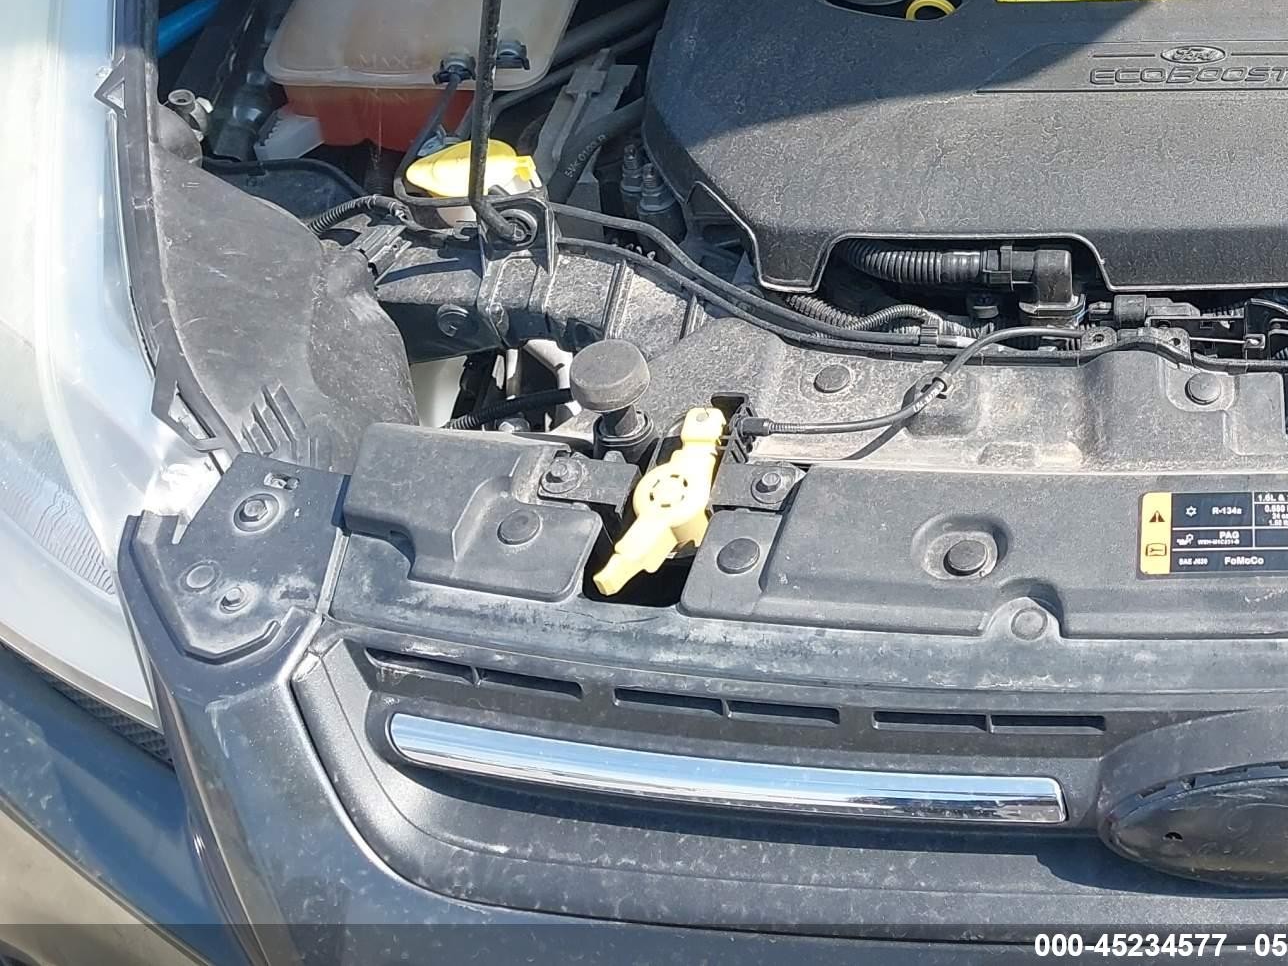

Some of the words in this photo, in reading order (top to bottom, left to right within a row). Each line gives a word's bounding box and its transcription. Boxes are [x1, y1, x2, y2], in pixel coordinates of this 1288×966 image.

[1258, 493, 1277, 502] 1.6L
[1212, 506, 1243, 515] R-134a
[1224, 556, 1265, 565] FoMoCo
